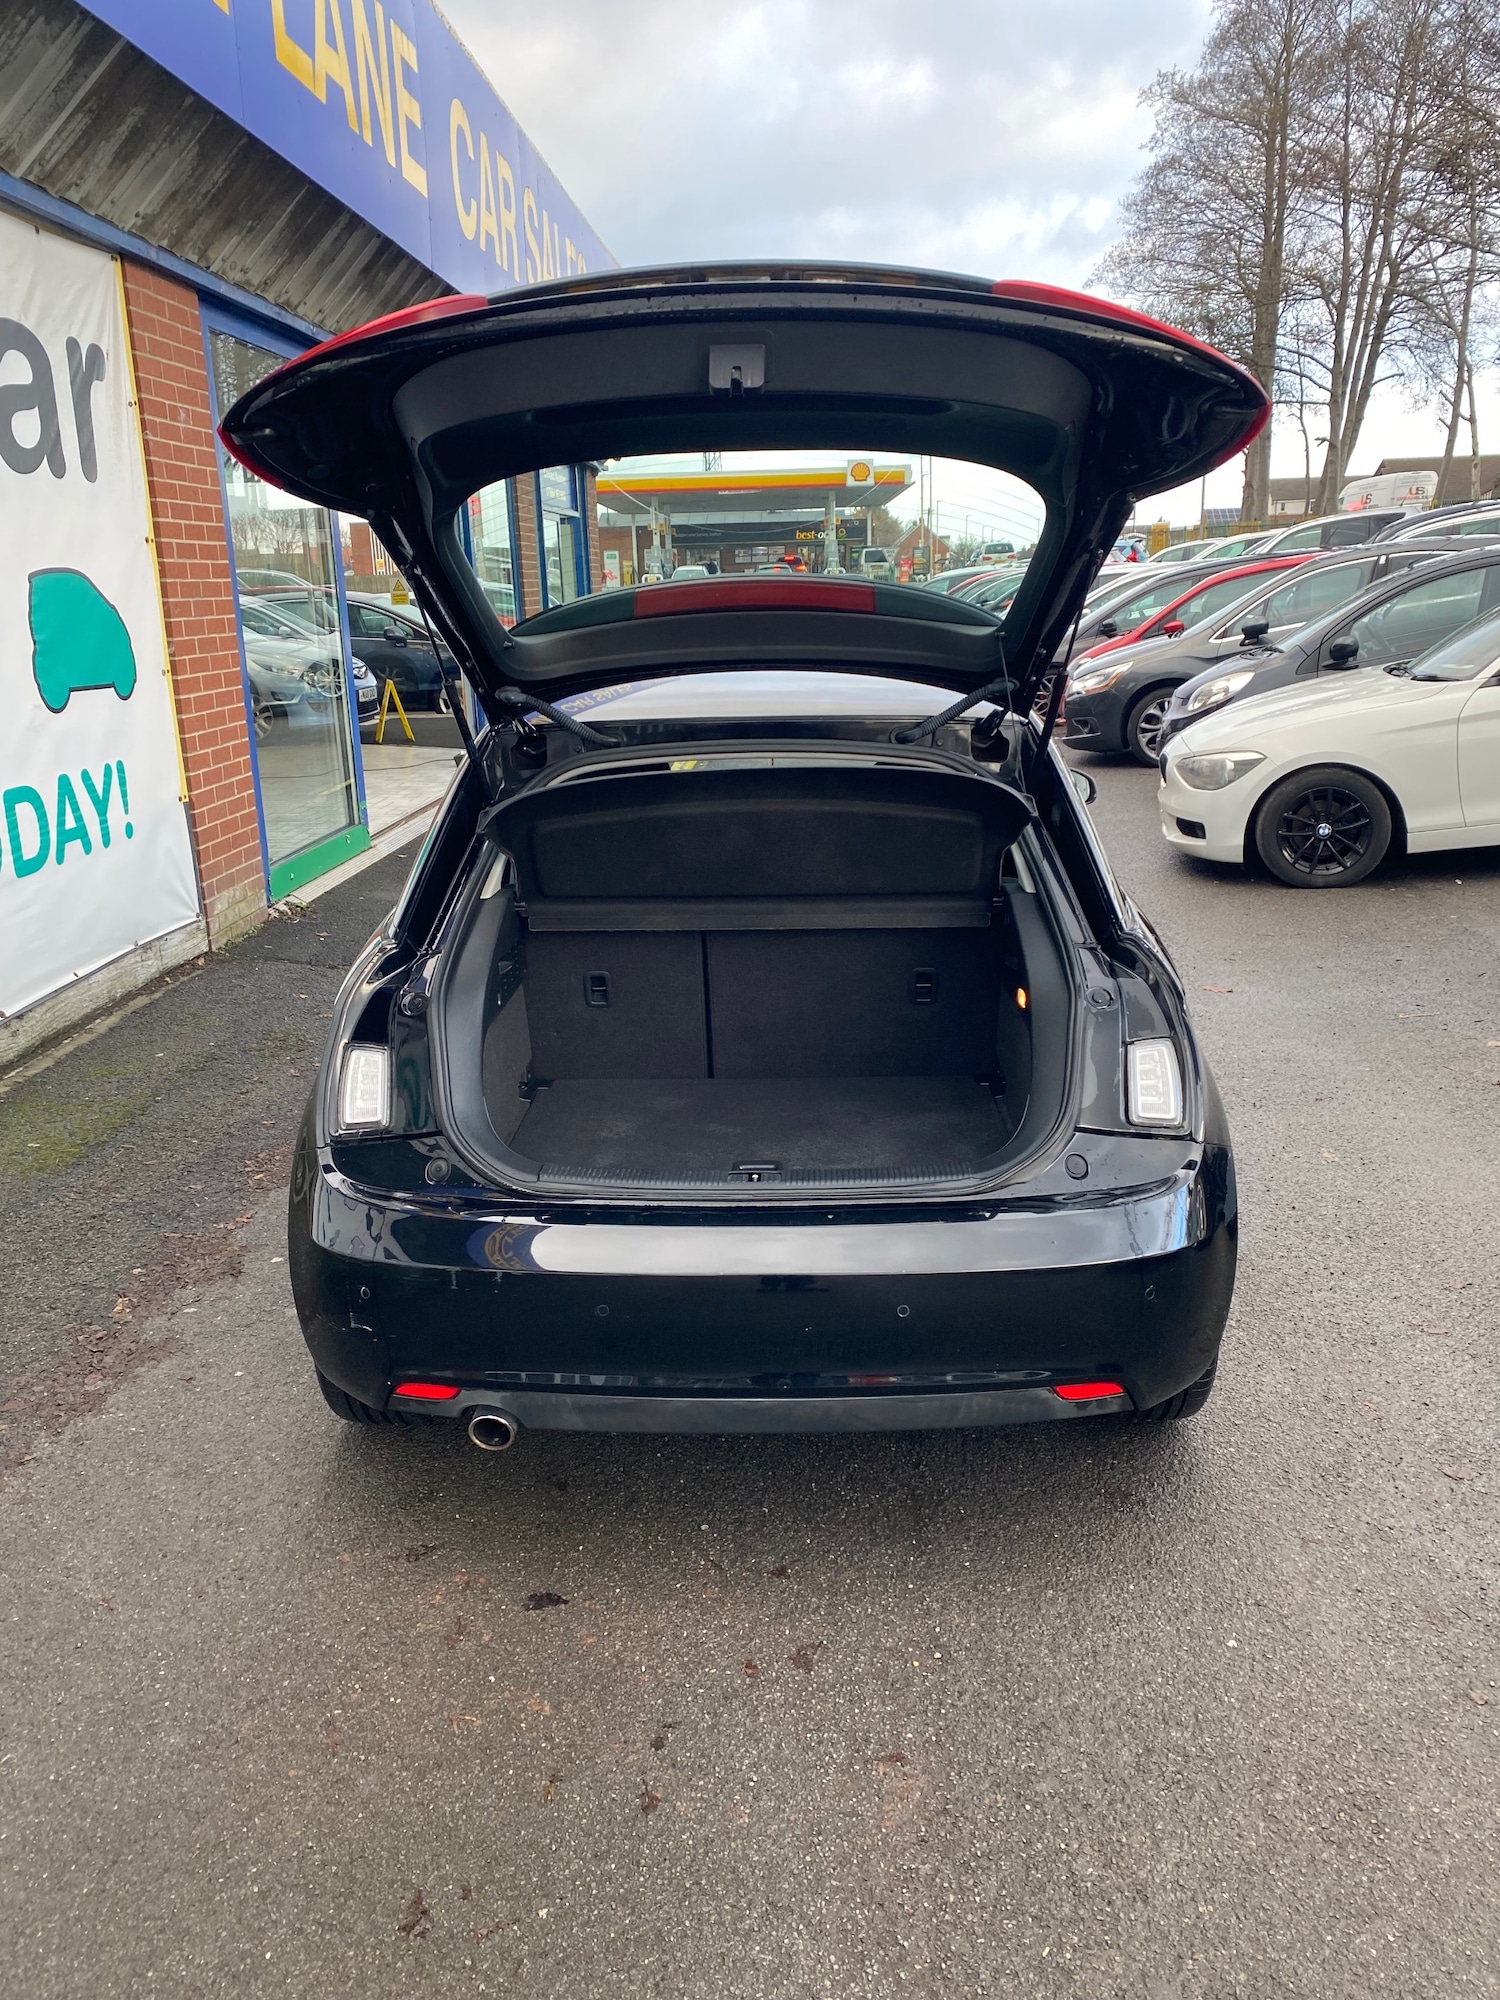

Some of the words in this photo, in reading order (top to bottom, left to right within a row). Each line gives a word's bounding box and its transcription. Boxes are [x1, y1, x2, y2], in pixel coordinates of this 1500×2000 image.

[450, 98, 520, 282] CAR
[796, 529, 827, 540] best-o
[0, 760, 134, 878] DAY!
